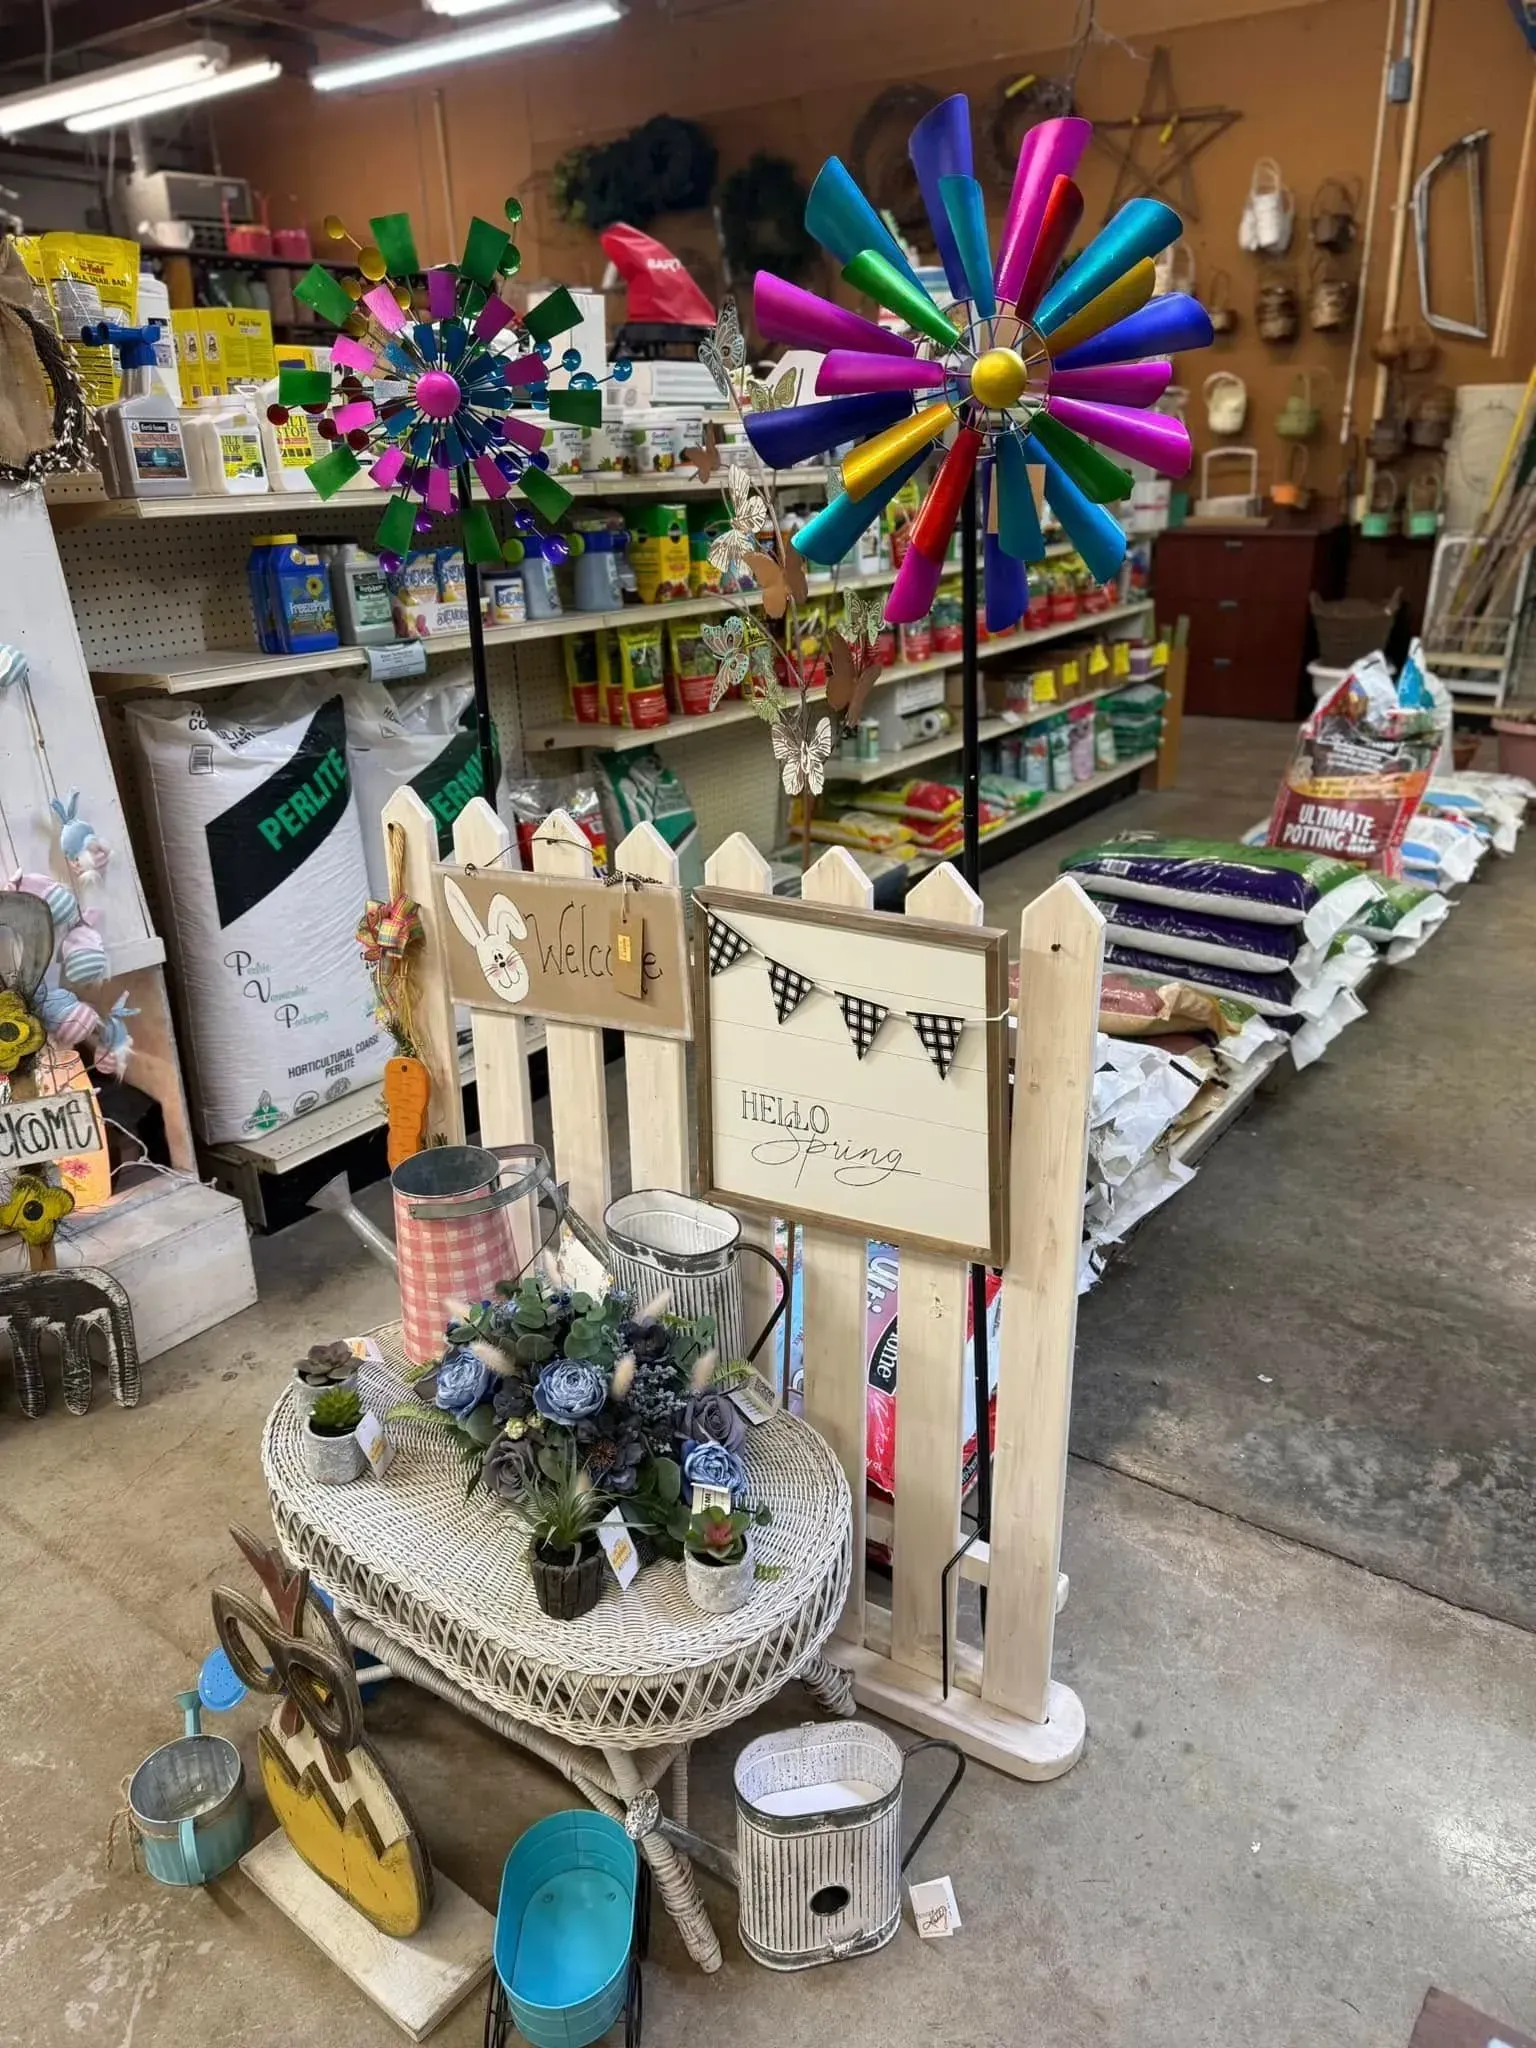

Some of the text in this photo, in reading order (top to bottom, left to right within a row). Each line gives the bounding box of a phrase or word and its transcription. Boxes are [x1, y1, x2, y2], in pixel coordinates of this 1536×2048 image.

[256, 747, 347, 851] PERLITE
[1299, 804, 1376, 837] ULTIMATE
[1282, 823, 1346, 851] POTTING
[288, 1047, 355, 1079] HORTICULTURAL
[325, 1057, 355, 1078] PERLITE
[741, 1090, 830, 1134] HELLO
